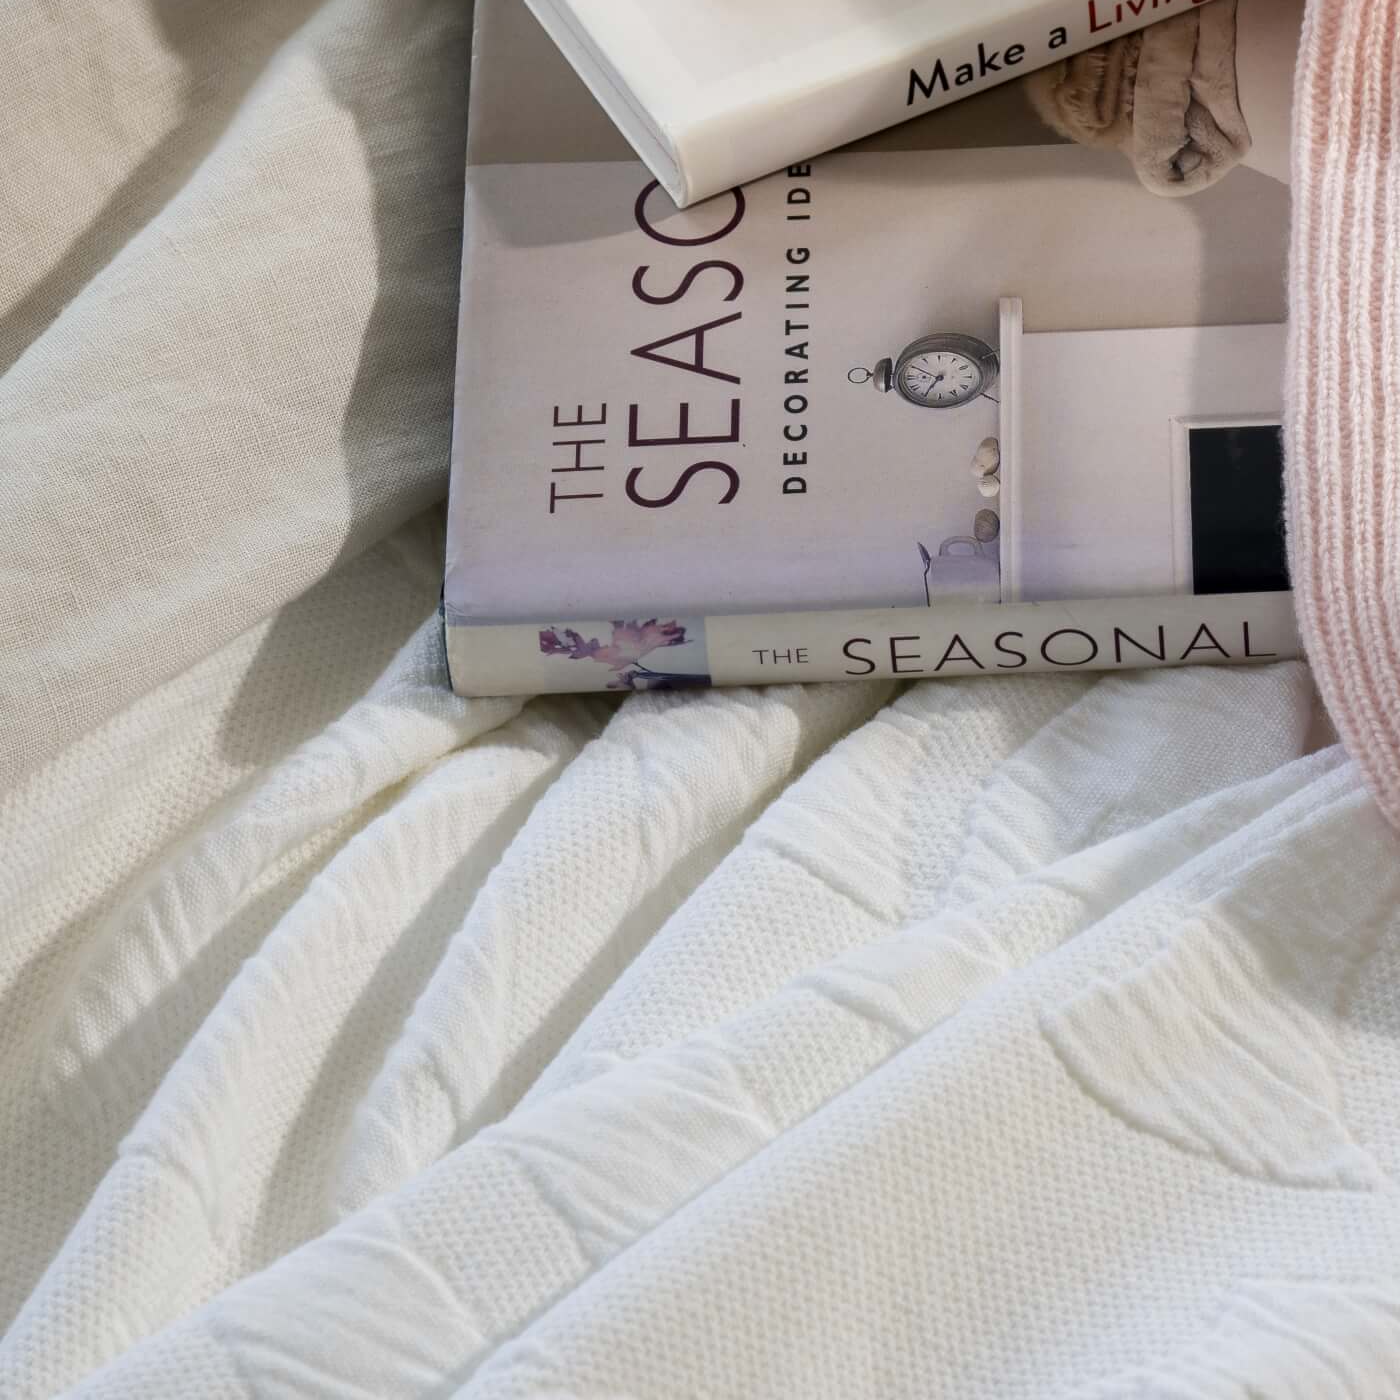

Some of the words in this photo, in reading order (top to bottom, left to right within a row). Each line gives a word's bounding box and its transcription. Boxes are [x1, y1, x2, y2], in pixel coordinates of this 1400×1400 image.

[906, 42, 1026, 106] Make
[1047, 25, 1068, 50] a
[786, 162, 812, 221] IDE
[625, 178, 746, 509] SEASO
[782, 247, 811, 495] DECORATING
[549, 402, 607, 514] THE
[751, 647, 809, 665] THE
[841, 620, 1278, 677] SEASONAL
